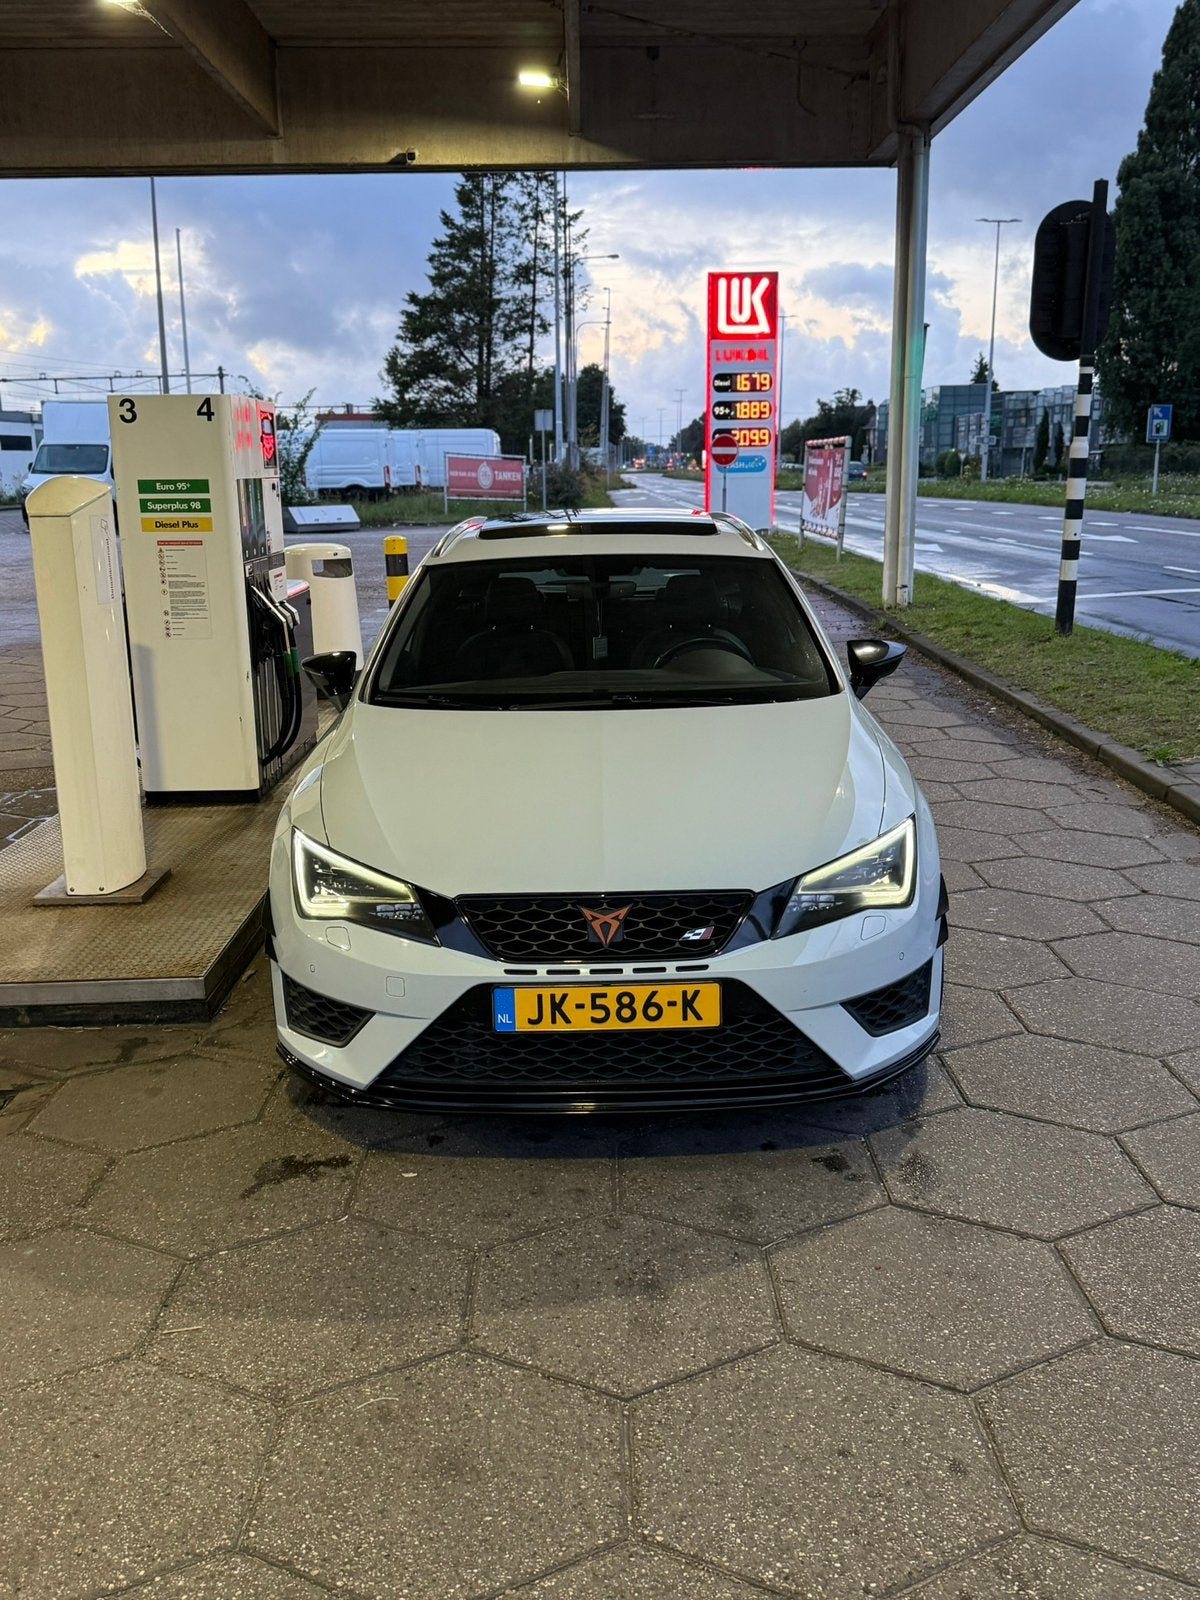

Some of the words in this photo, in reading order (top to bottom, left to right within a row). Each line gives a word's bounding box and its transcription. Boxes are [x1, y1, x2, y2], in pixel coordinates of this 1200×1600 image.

[119, 398, 137, 423] 3
[197, 397, 214, 421] 4
[736, 401, 770, 418] 1889
[147, 502, 188, 511] Superplus
[190, 501, 201, 510] 98
[527, 989, 704, 1025] JK-586-K
[498, 1014, 512, 1024] NL
